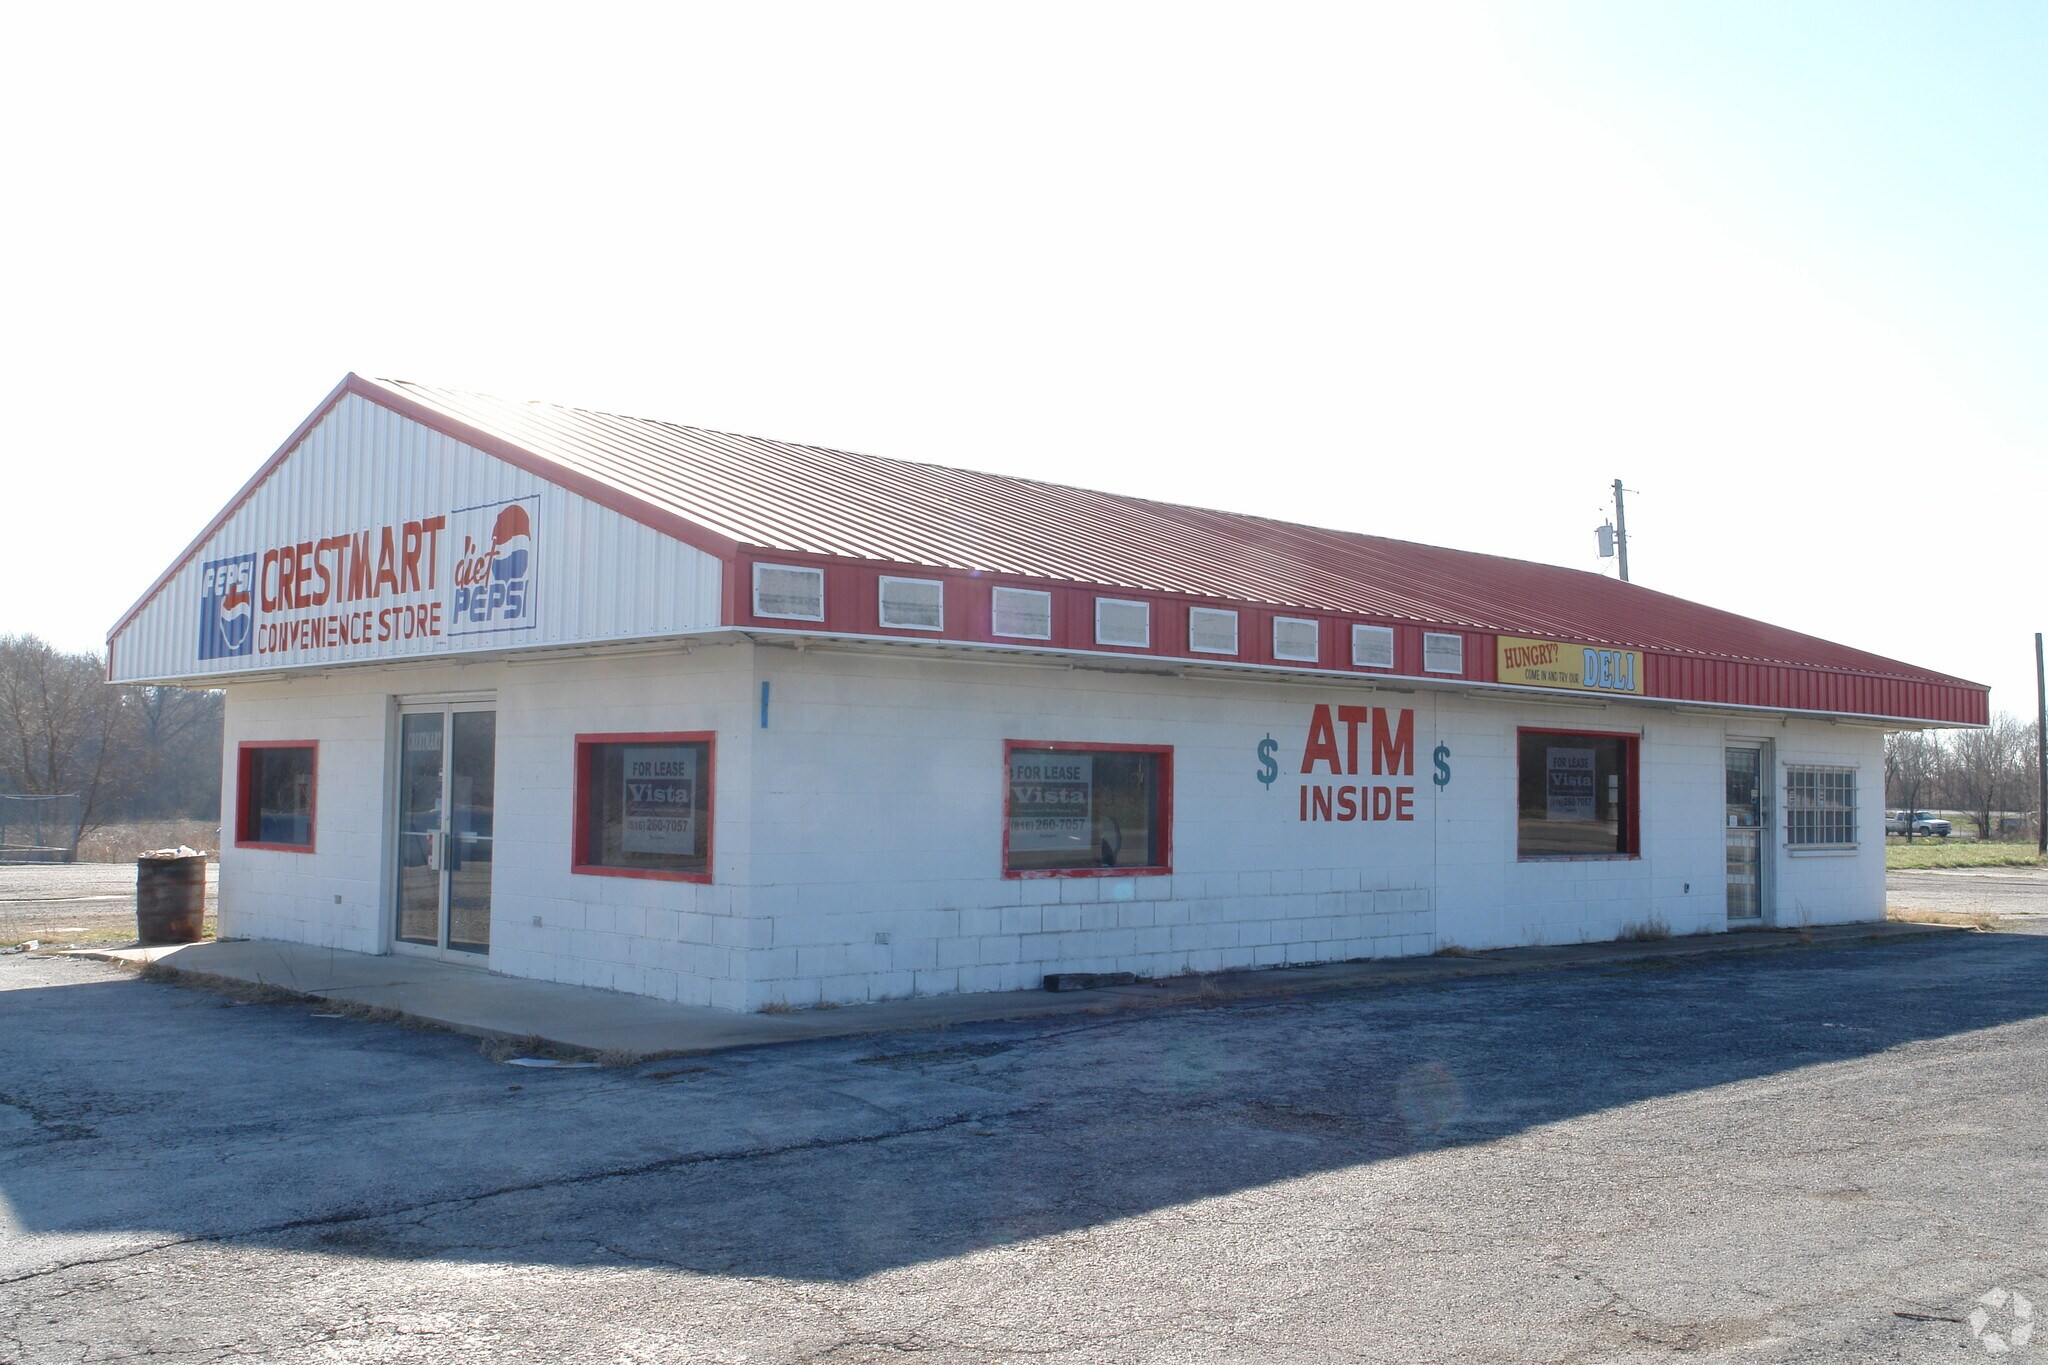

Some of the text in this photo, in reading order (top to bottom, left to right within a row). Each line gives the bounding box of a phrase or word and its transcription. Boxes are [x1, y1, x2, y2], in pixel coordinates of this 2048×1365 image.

[260, 515, 446, 613] CRESTMART
[454, 535, 501, 591] diet
[202, 560, 254, 598] PEPSI
[453, 579, 529, 624] PEPSI
[257, 602, 442, 655] CONVENIENCE STORE
[1503, 643, 1559, 669] HUNGRY?
[1582, 648, 1636, 691] DELI
[1525, 668, 1580, 684] COME IN AND TRY OUR
[1300, 703, 1415, 776] ATM
[633, 762, 685, 776] FOR LEASE
[1017, 765, 1041, 780] FOR
[1044, 766, 1081, 780] LEASE
[1256, 732, 1279, 791] $
[1433, 739, 1451, 792] $
[1553, 757, 1589, 768] FOR LEASE
[628, 784, 689, 803] Vista
[1550, 772, 1592, 786] Vista
[1011, 786, 1086, 804] Vista
[1299, 785, 1415, 822] INSIDE
[647, 819, 688, 832] 260-7057
[1035, 818, 1086, 831] 260-7057
